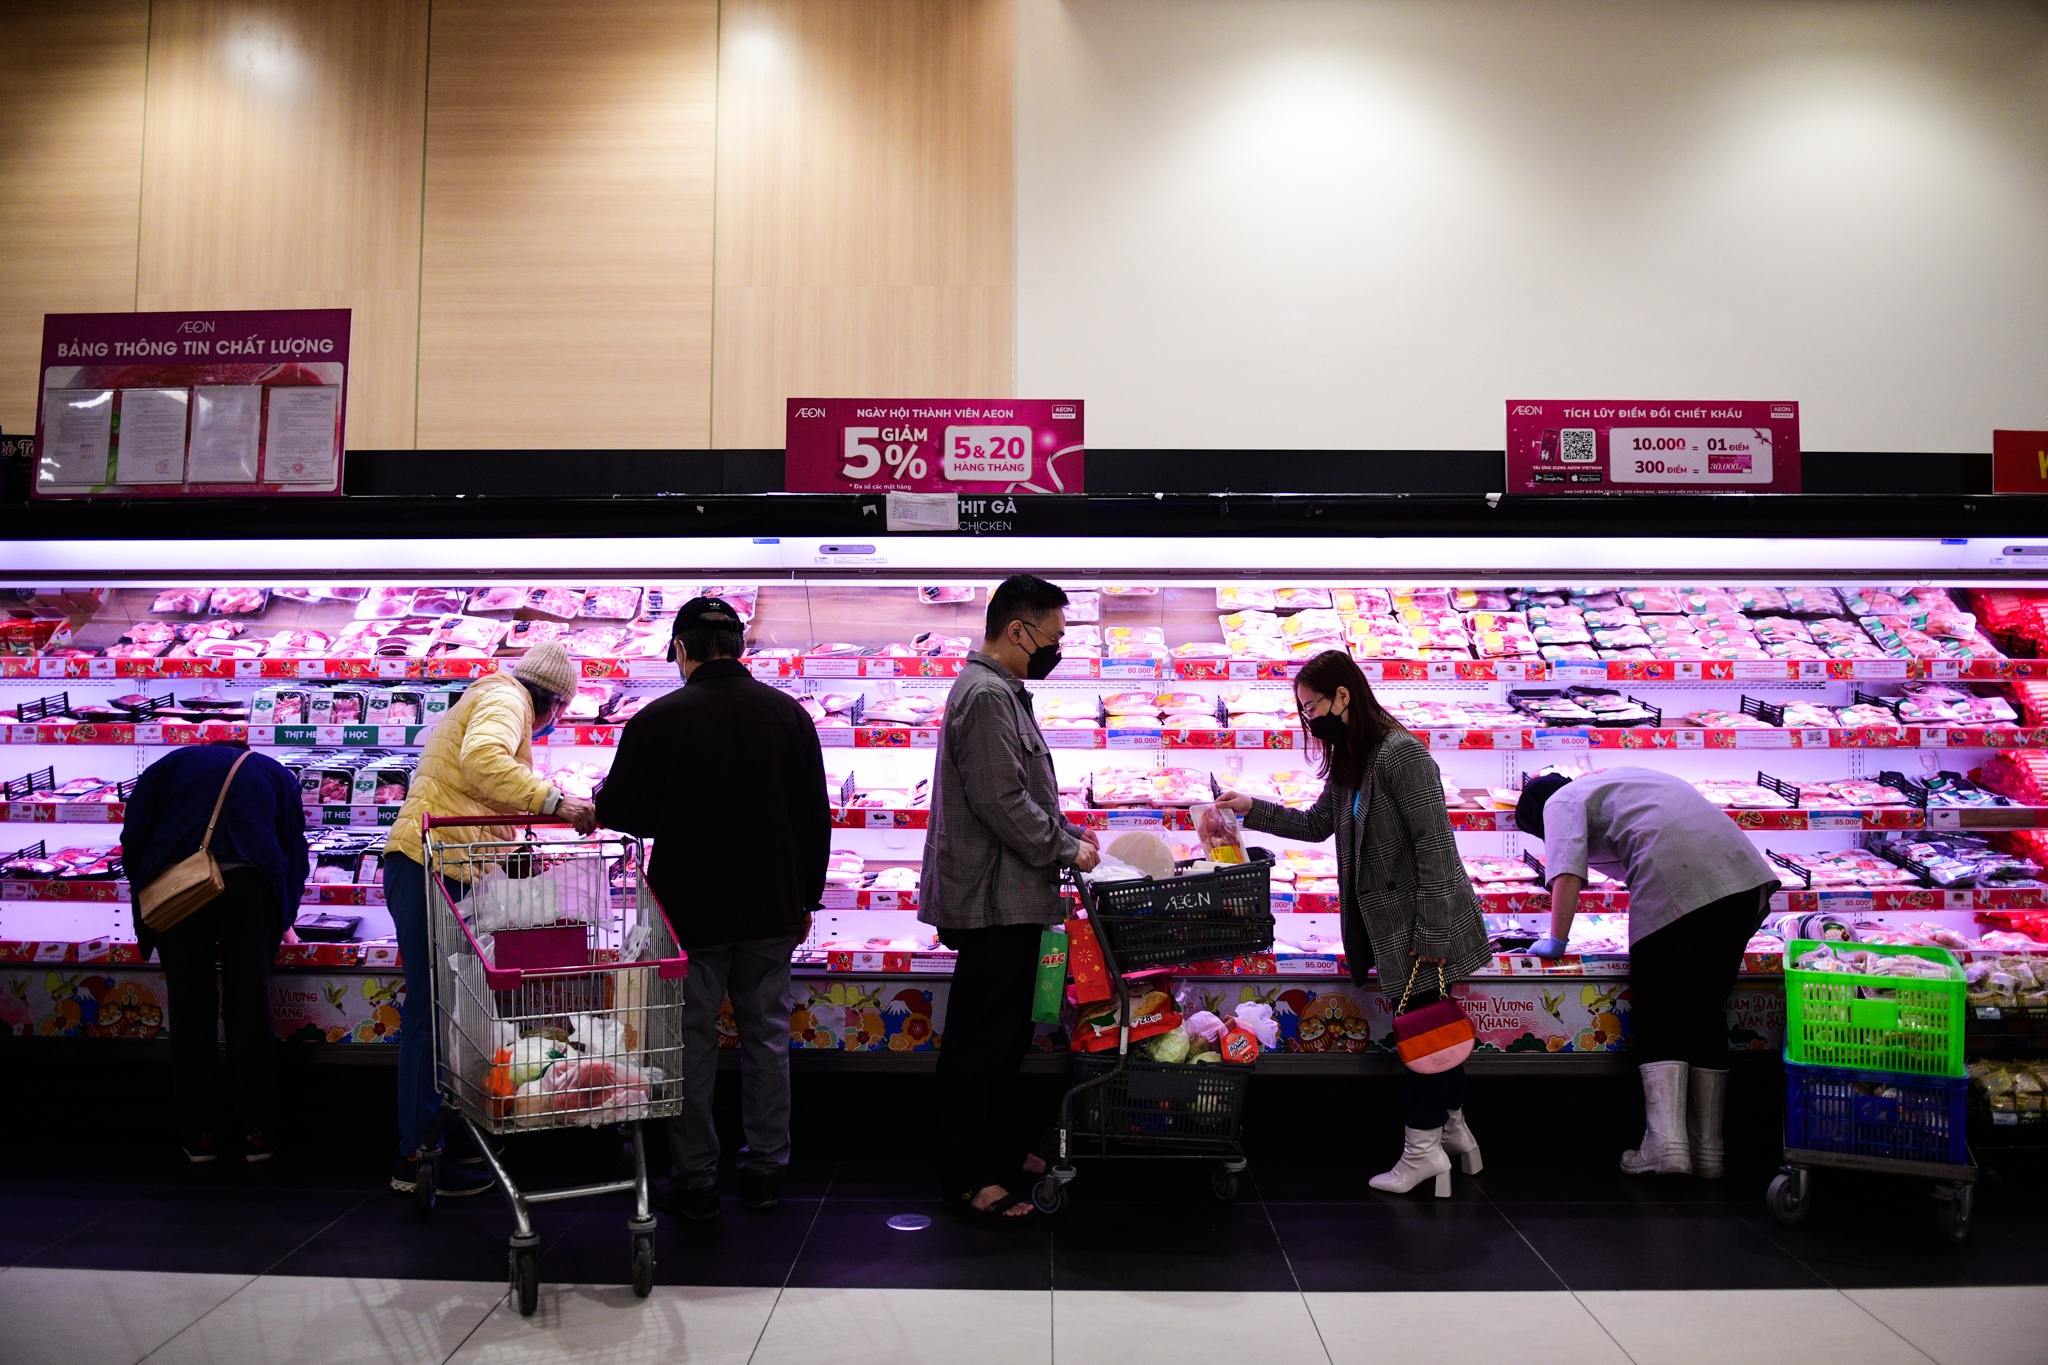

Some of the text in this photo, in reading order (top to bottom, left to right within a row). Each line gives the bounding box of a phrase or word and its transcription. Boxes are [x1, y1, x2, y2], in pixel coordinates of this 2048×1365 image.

[57, 333, 334, 358] BẢNG THÔNG TIN CHẤT LƯỢNG
[856, 406, 1014, 420] NGÀY HỘI THÀNH VIÊN AEON
[1563, 407, 1590, 418] TÍCH
[1593, 407, 1616, 418] LŨY
[1618, 406, 1647, 418] ĐIỂM
[1674, 407, 1707, 418] CHIẾT
[1710, 407, 1743, 419] KHẤU
[881, 424, 928, 442] GIẢM
[1632, 437, 1686, 451] 10.000
[1707, 438, 1728, 451] 01
[1729, 441, 1750, 451] ĐIỂM
[954, 461, 1025, 472] HÀNG THÁNG
[1634, 460, 1665, 473] 300
[1667, 464, 1687, 474] ĐIỂM
[896, 483, 912, 491] hàng
[990, 496, 1018, 514] GÀ
[958, 521, 1012, 531] CHICKEN
[284, 730, 304, 740] THỊT
[349, 730, 369, 741] HỌC
[1140, 1014, 1151, 1025] 28
[1475, 1013, 1519, 1032] KHANG
